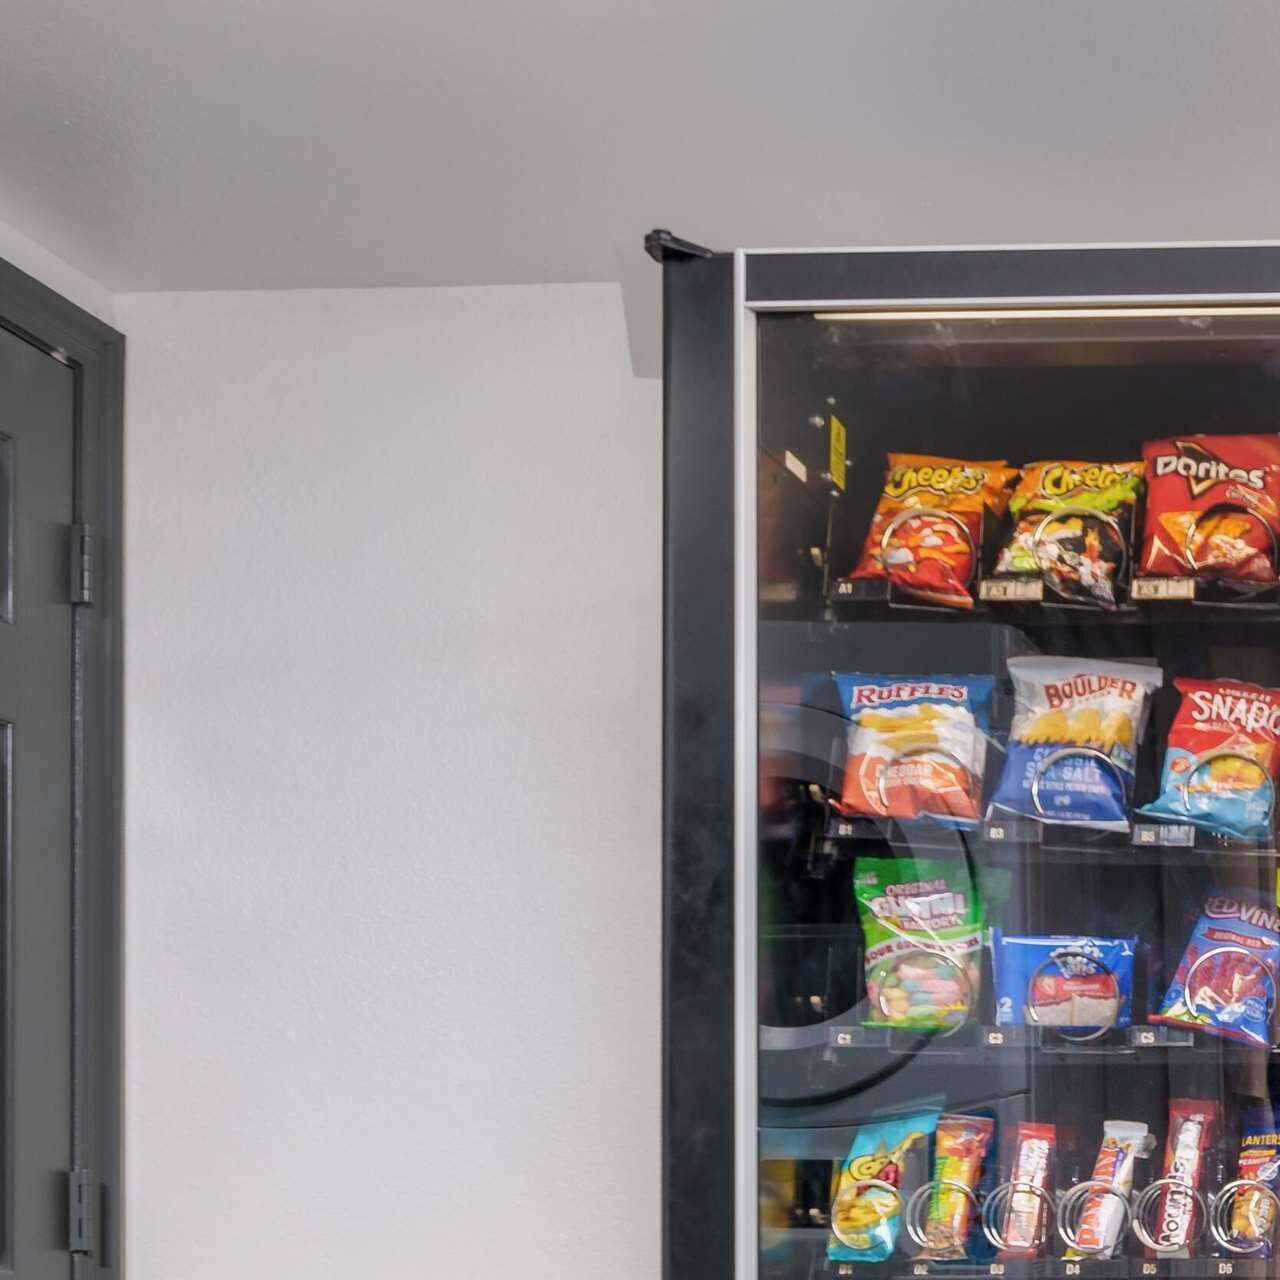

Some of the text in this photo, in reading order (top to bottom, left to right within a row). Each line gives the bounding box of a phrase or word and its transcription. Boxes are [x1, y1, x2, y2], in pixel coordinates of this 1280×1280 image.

[1156, 454, 1265, 490] Doritos
[854, 683, 966, 704] RUFFLES
[1043, 673, 1137, 709] BOULDER
